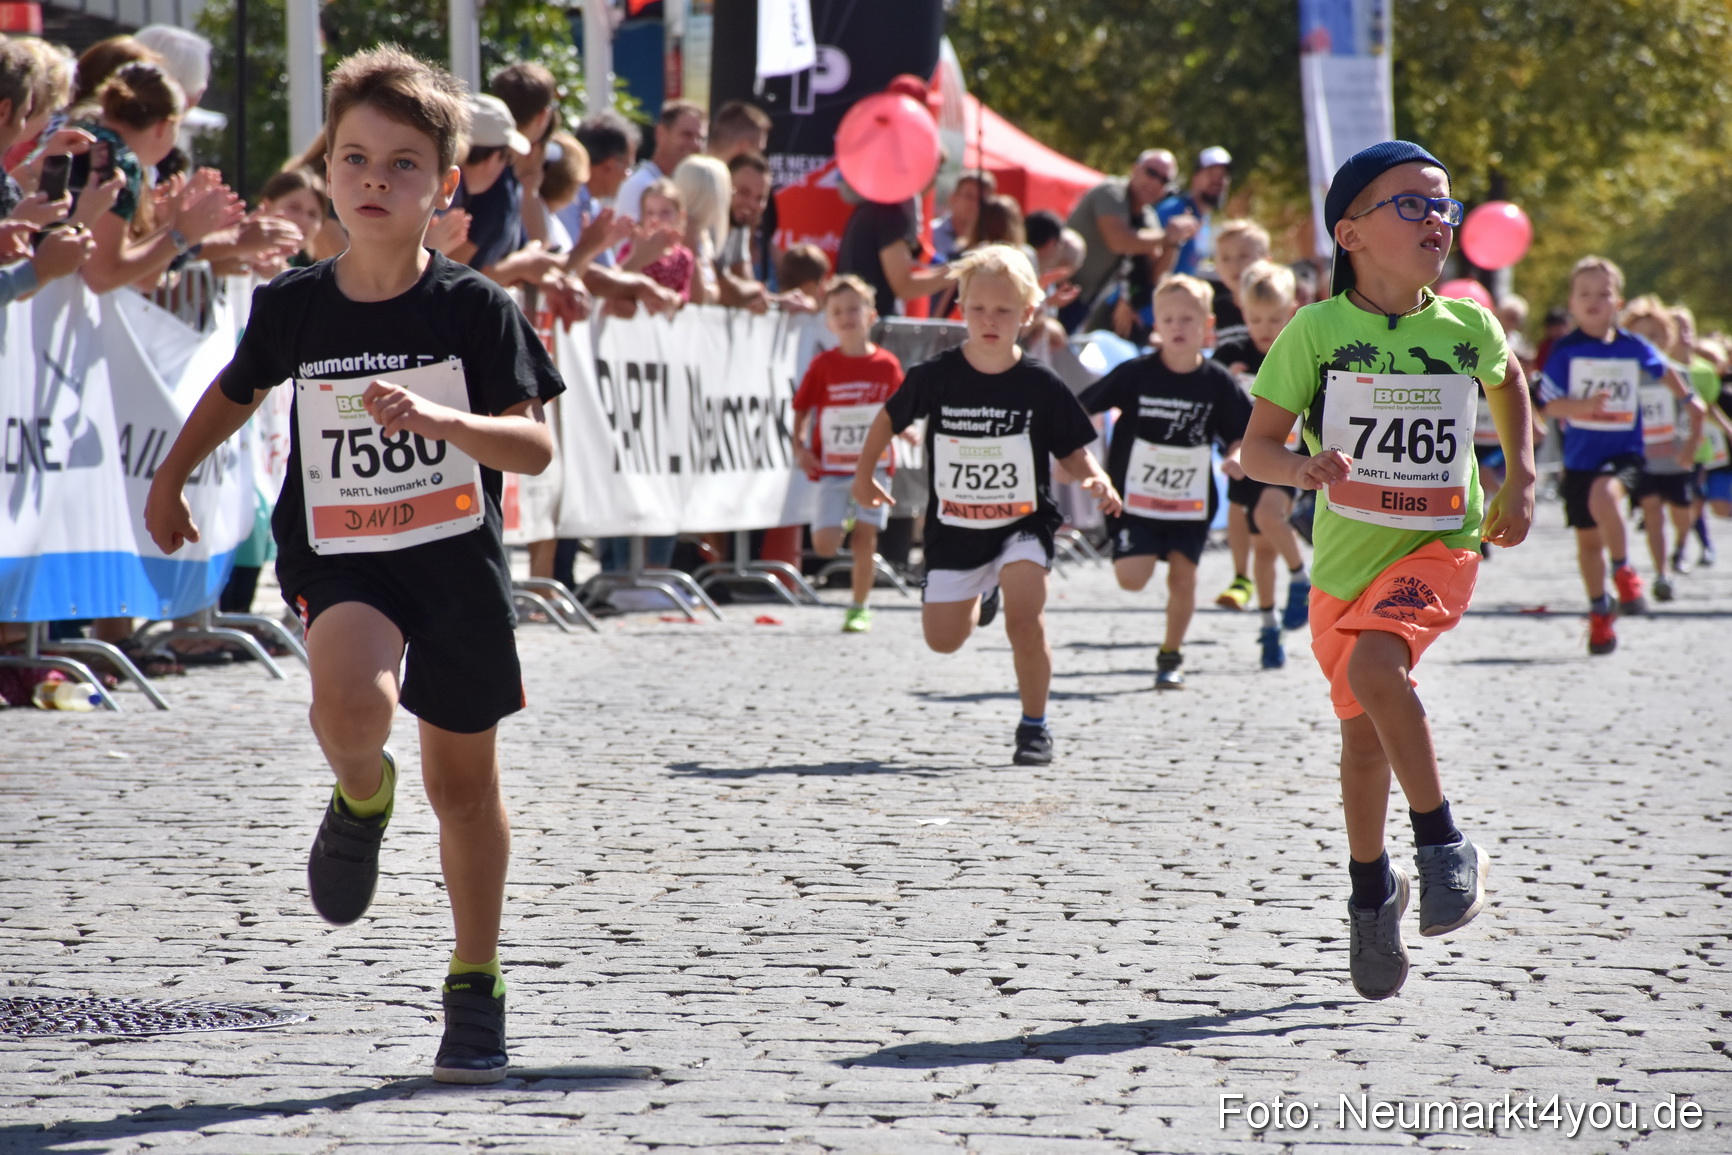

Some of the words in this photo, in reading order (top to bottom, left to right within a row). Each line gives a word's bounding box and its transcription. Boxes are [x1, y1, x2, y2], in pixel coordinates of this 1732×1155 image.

[299, 352, 409, 379] Neumarkter
[1373, 387, 1442, 405] BOCK
[941, 405, 1008, 419] Neumarkter
[830, 425, 872, 447] 737
[941, 419, 994, 434] Stadtlauf
[1349, 416, 1457, 465] 7465
[321, 426, 447, 479] 7580
[309, 469, 320, 480] B5
[949, 462, 1019, 491] 7523
[1141, 463, 1197, 490] 7427
[1357, 467, 1391, 480] PARTL
[1393, 471, 1440, 481] Neumarkt
[339, 486, 372, 498] PARTL
[374, 477, 428, 496] Neumarkt
[941, 501, 1013, 520] ANTON
[1381, 490, 1428, 512] Elias
[344, 502, 415, 531] DAVID
